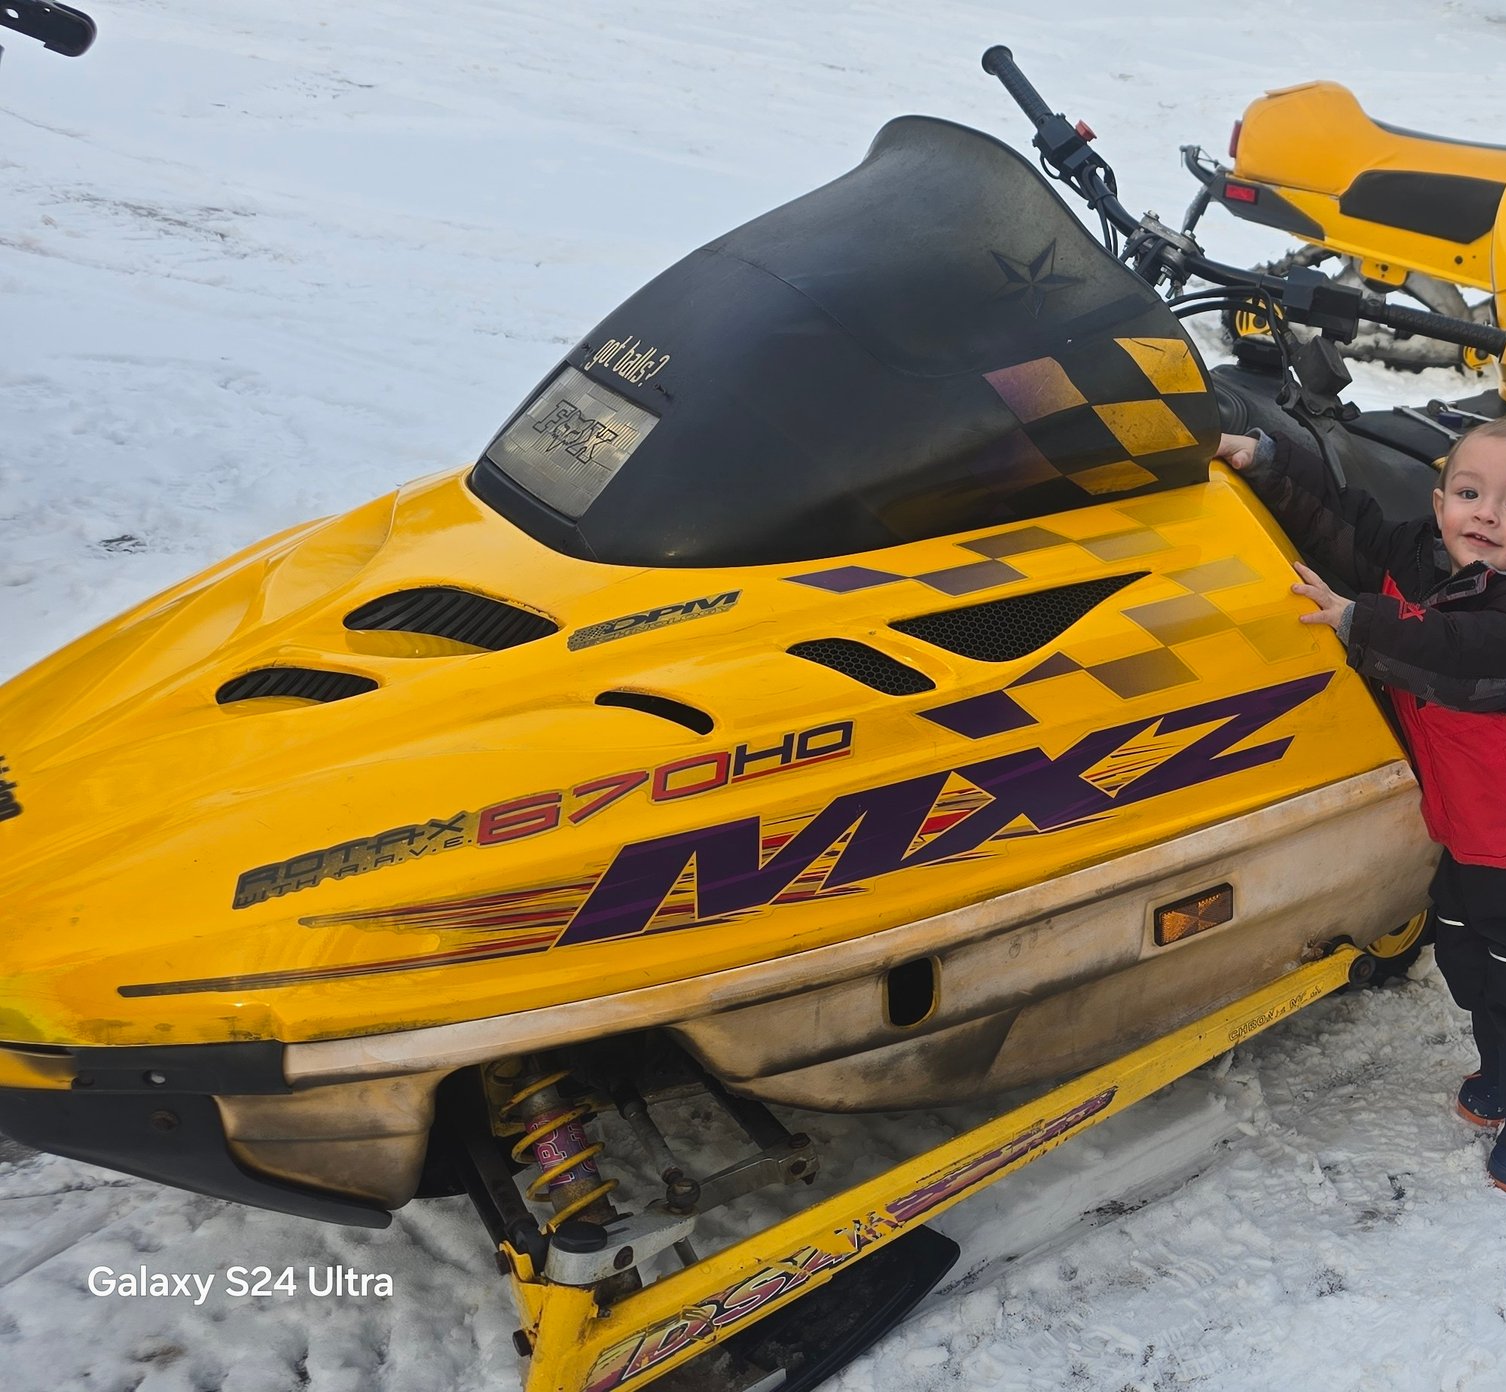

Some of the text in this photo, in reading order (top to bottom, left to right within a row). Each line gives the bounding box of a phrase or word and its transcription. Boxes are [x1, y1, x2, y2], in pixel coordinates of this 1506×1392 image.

[584, 336, 671, 388] got balls?
[604, 590, 741, 634] DPM
[554, 670, 1338, 948] MXZ
[237, 813, 467, 895] ROTAX
[236, 874, 317, 906] WITH
